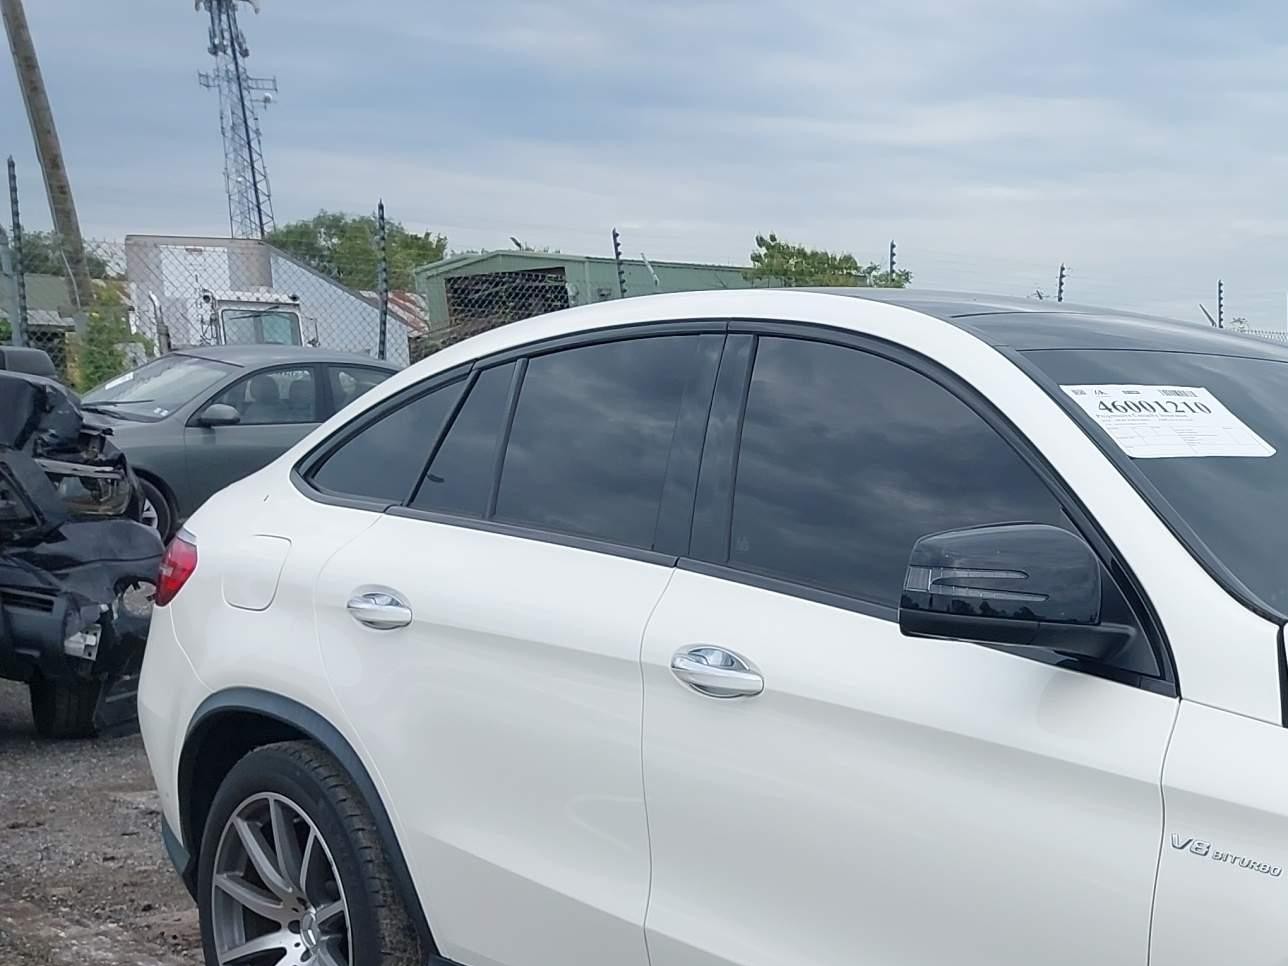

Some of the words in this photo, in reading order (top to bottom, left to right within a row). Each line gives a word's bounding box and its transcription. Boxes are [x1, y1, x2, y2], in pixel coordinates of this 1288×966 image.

[1098, 400, 1212, 414] 46001210
[1170, 832, 1212, 856] V8
[1211, 850, 1283, 877] BITURBO
